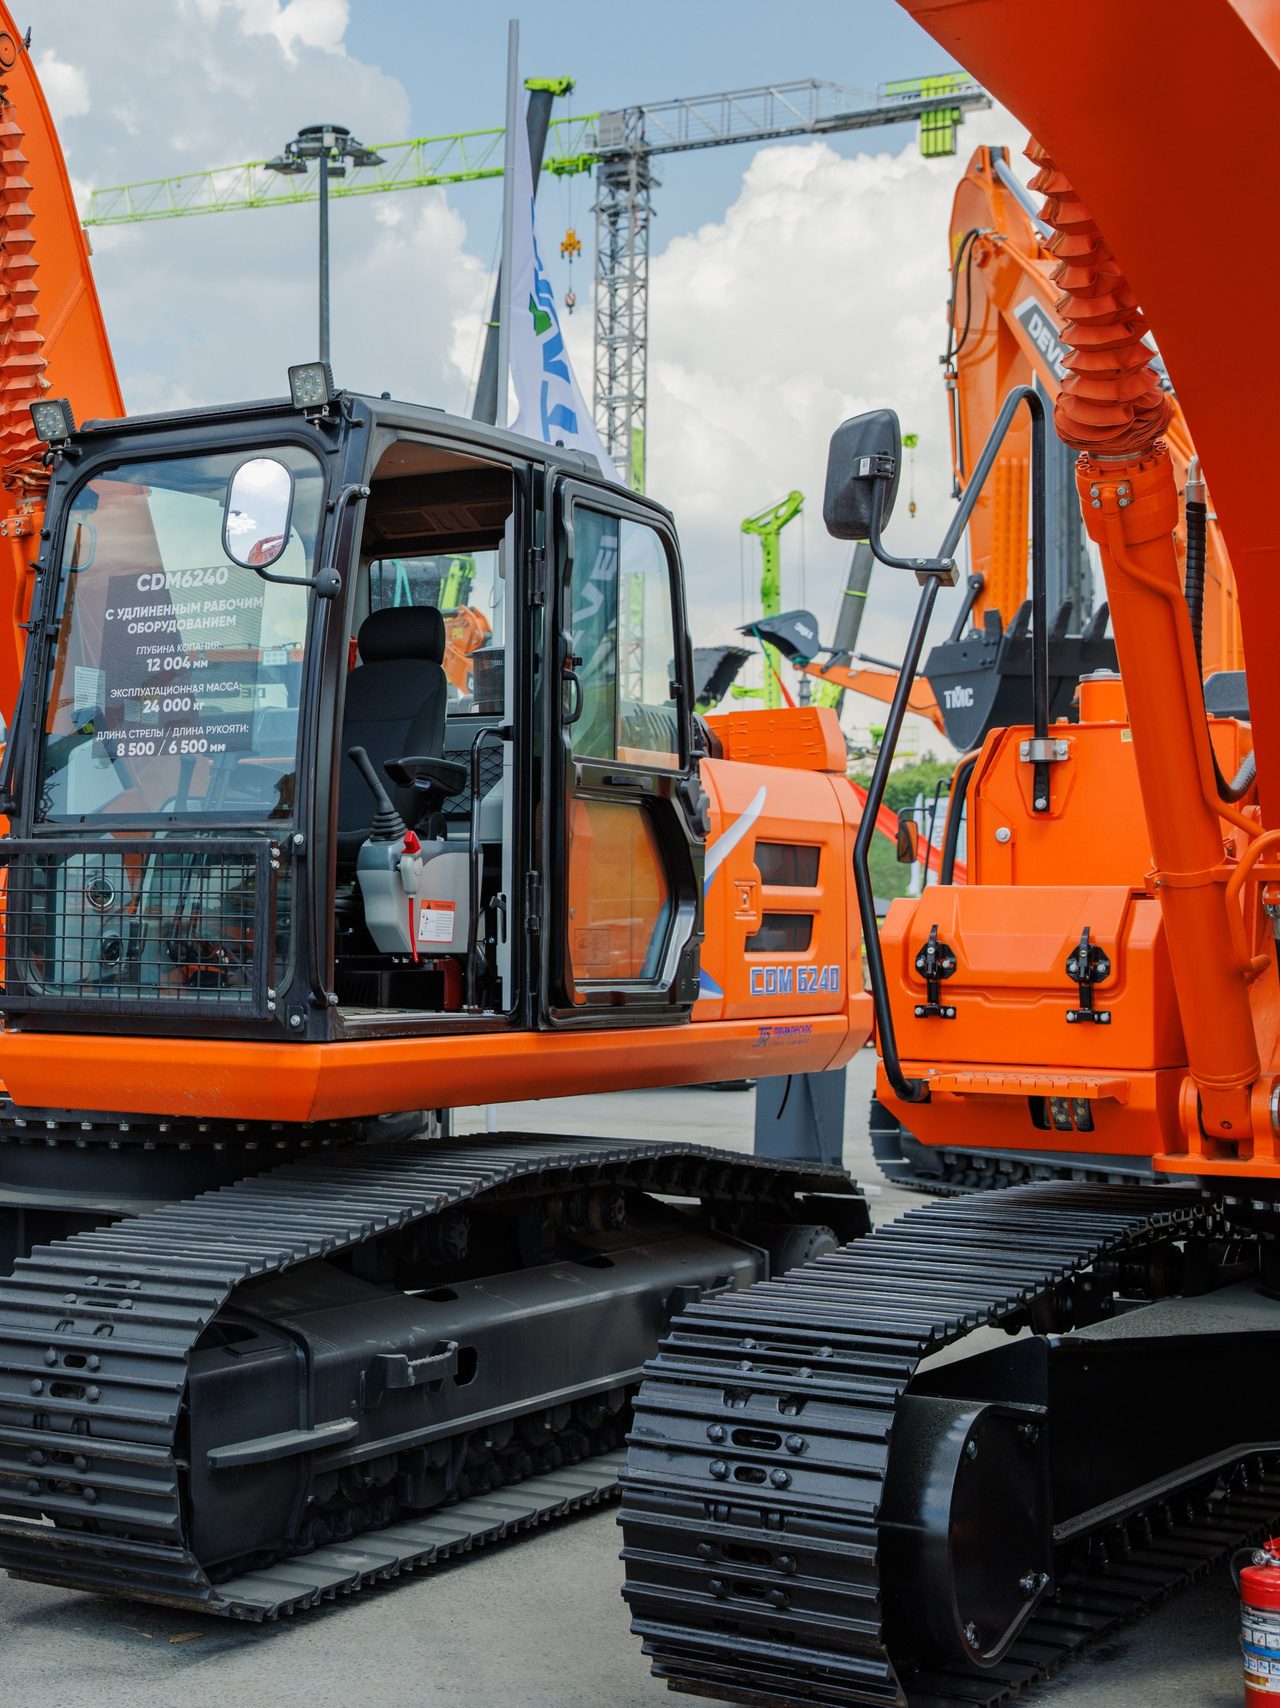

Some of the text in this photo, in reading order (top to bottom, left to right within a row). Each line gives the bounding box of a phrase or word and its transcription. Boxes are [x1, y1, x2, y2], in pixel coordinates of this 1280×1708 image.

[136, 566, 230, 592] CDM6240
[105, 596, 265, 621] С УДЛИНЕННЫМ РАБОЧИМ
[127, 614, 237, 635] ОБОРУДОВАНИЕМ
[136, 641, 222, 656] ГЛУБИНА КОПАНИЯ:
[146, 656, 209, 672] 12 004 мм
[110, 681, 242, 699] ЭКСПЛУАТАЦИОННАЯ МАССА:
[943, 686, 974, 709] TMC
[142, 699, 160, 714] 24
[162, 697, 192, 712] 000
[192, 701, 206, 712] кг
[96, 730, 127, 742] ДЛИНА
[128, 728, 164, 739] СТРЕЛЫ
[172, 726, 204, 738] ДЛИНА
[205, 724, 250, 735] РУКОЯТИ:
[127, 741, 156, 756] 500
[179, 738, 209, 754] 500
[209, 743, 227, 753] мм
[750, 965, 840, 996] CDM 6240
